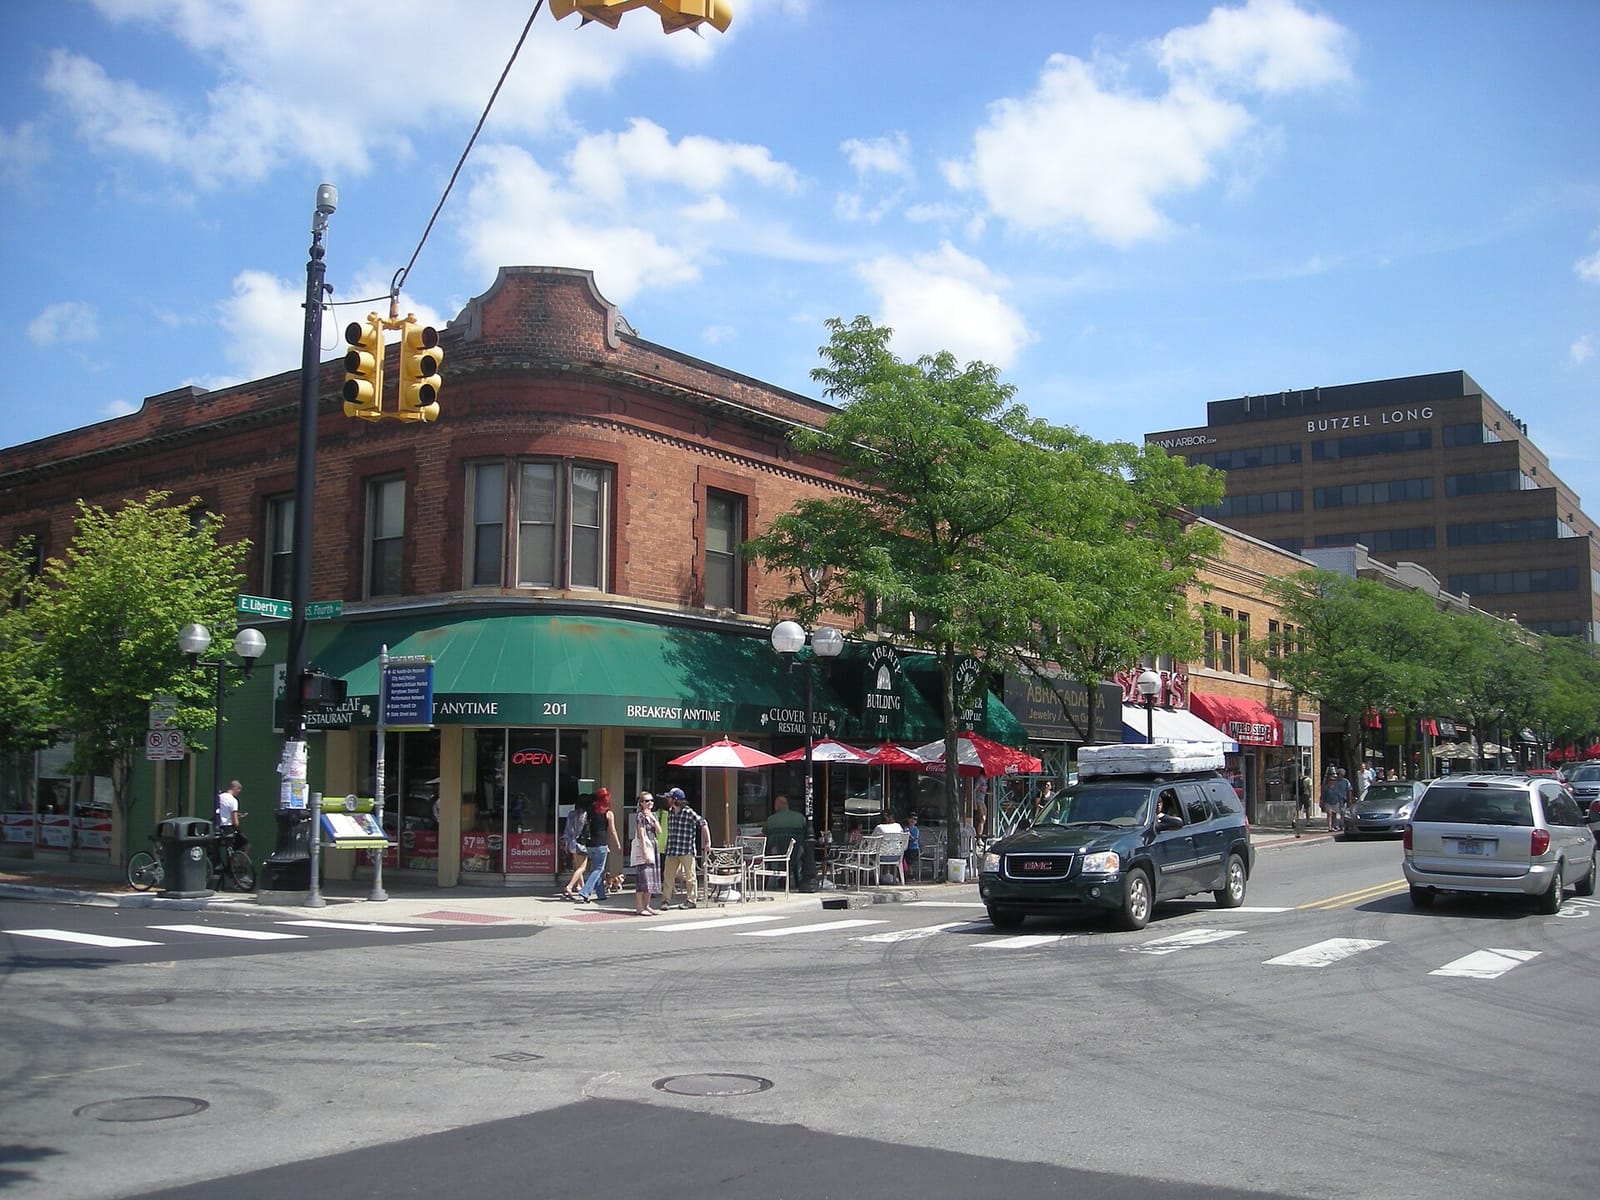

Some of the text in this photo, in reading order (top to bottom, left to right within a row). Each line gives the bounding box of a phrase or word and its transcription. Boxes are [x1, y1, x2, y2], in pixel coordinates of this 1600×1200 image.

[1307, 407, 1433, 432] BUTZEL LONG
[250, 599, 278, 615] Liberty
[314, 604, 333, 615] Fourth
[867, 645, 902, 674] LIBERTY
[336, 697, 361, 712] EAF
[440, 702, 498, 715] ANYTIME
[543, 702, 567, 715] 201
[866, 693, 901, 710] BUILDING
[307, 712, 354, 725] ESTAURANT
[627, 704, 721, 722] BREAKFAST ANYTIME
[769, 708, 828, 725] CLOVER EAF
[1028, 708, 1057, 723] Jewelry
[778, 722, 823, 735] RESTAUNT
[1230, 721, 1271, 743] WILD SIDE
[512, 752, 553, 765] OPEN
[521, 837, 541, 846] Club
[511, 847, 551, 857] Sandwich
[1023, 861, 1053, 870] GMC
